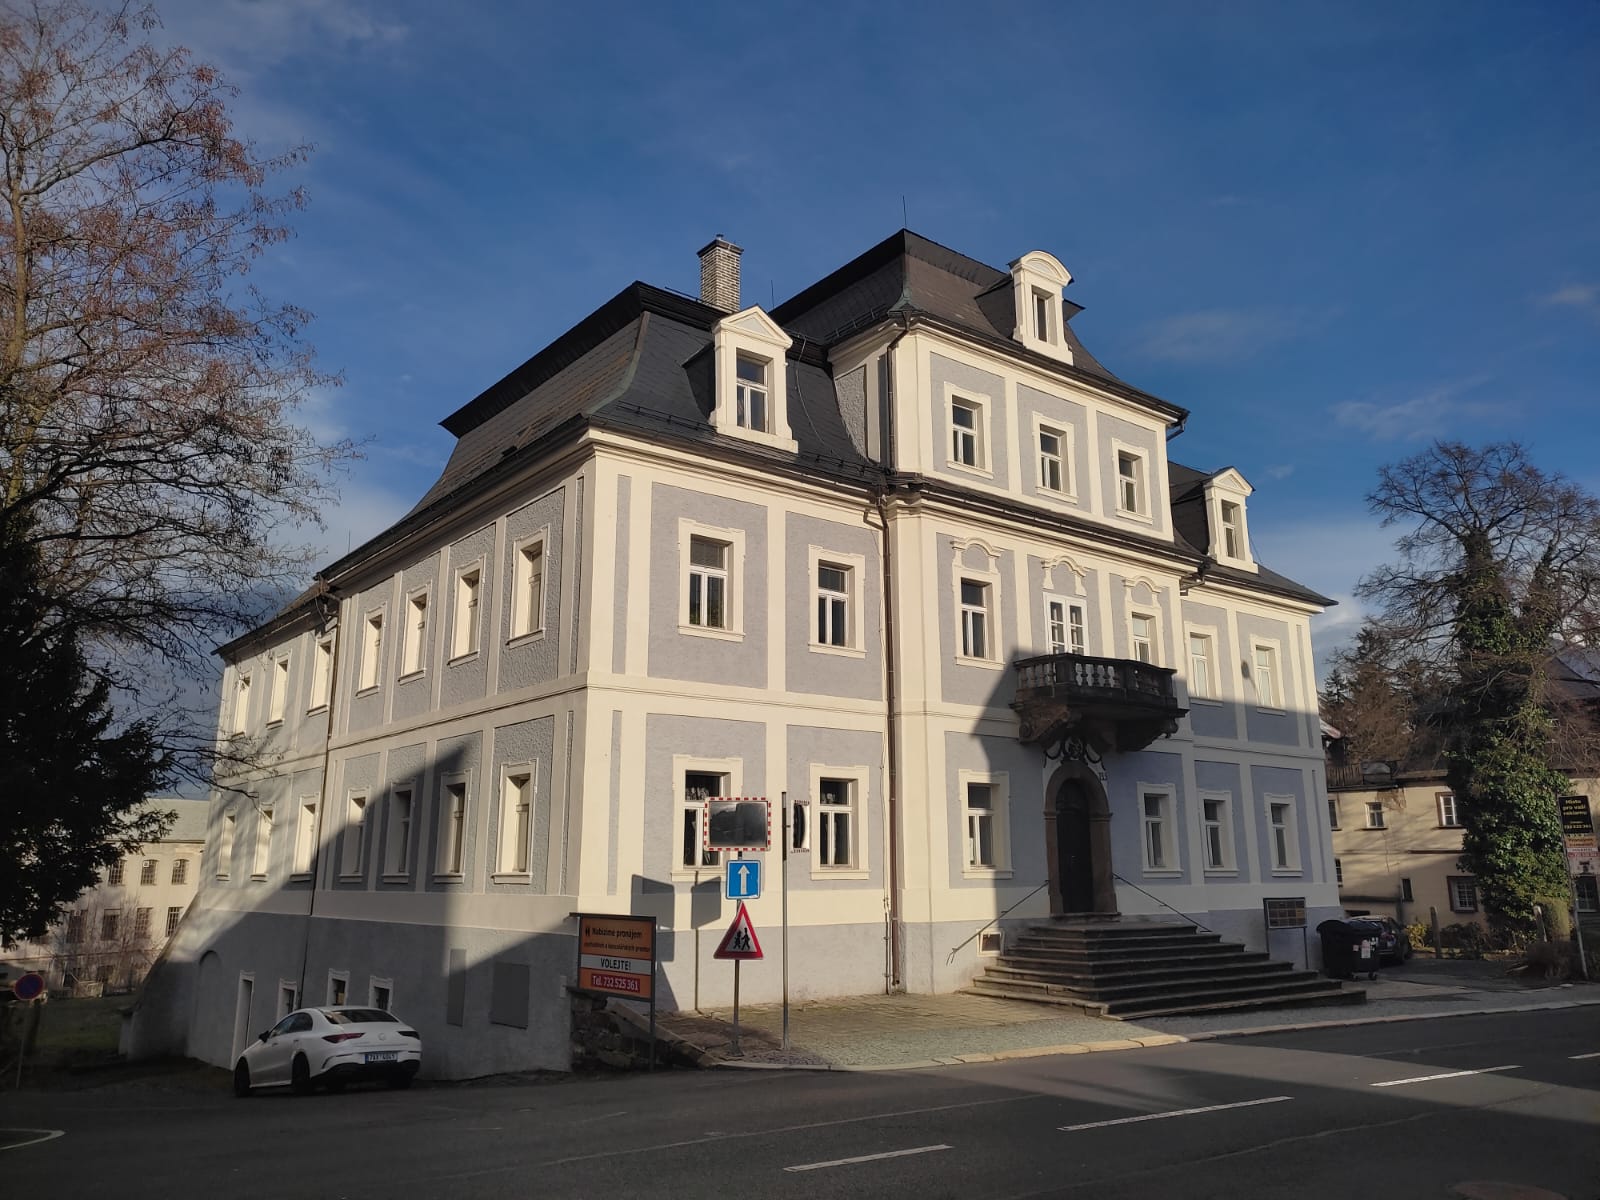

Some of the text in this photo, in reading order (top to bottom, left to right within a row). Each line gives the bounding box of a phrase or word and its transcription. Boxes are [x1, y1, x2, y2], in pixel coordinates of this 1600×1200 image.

[600, 957, 632, 971] VOLEJTE!
[592, 975, 639, 991] Tel. 732 525 361
